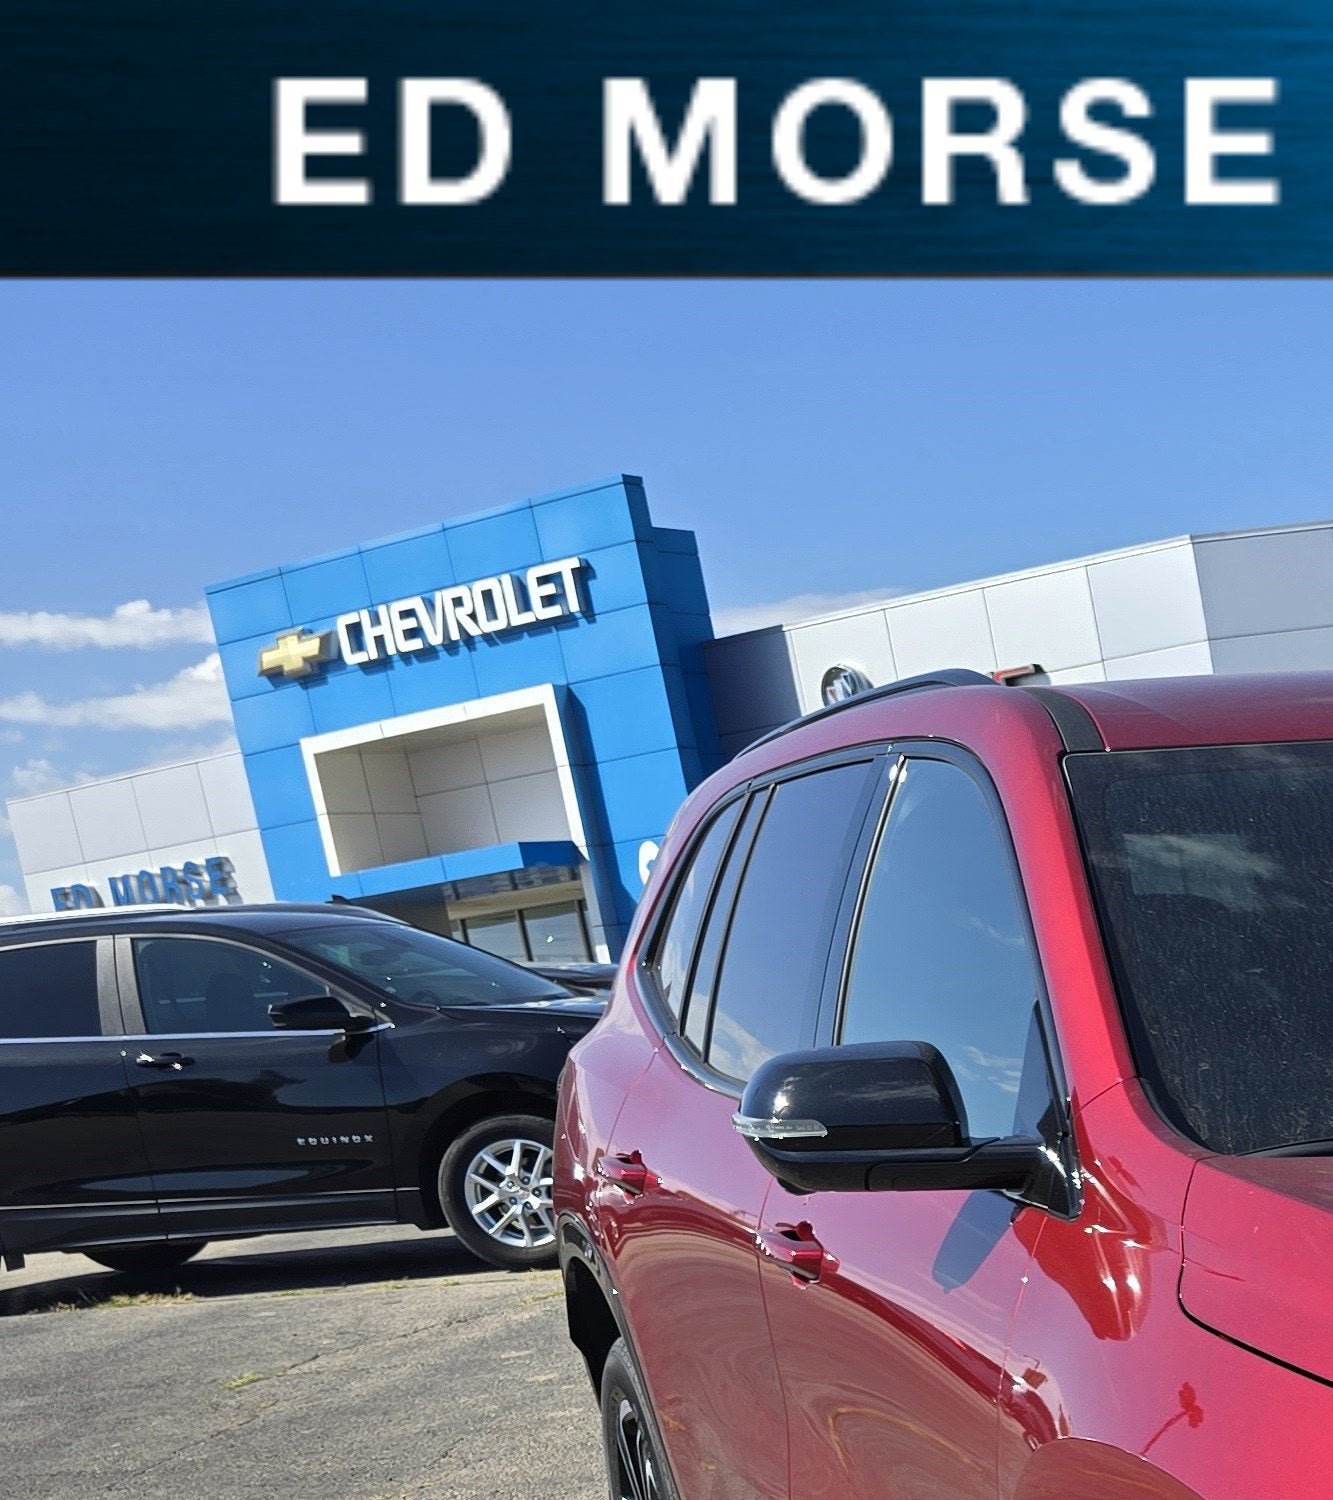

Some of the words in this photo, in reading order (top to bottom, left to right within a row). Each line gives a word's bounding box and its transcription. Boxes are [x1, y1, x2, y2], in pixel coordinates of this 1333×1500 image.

[336, 556, 582, 666] CHEVROLET
[108, 856, 232, 907] MORSE
[296, 1134, 374, 1146] EQUINOX
